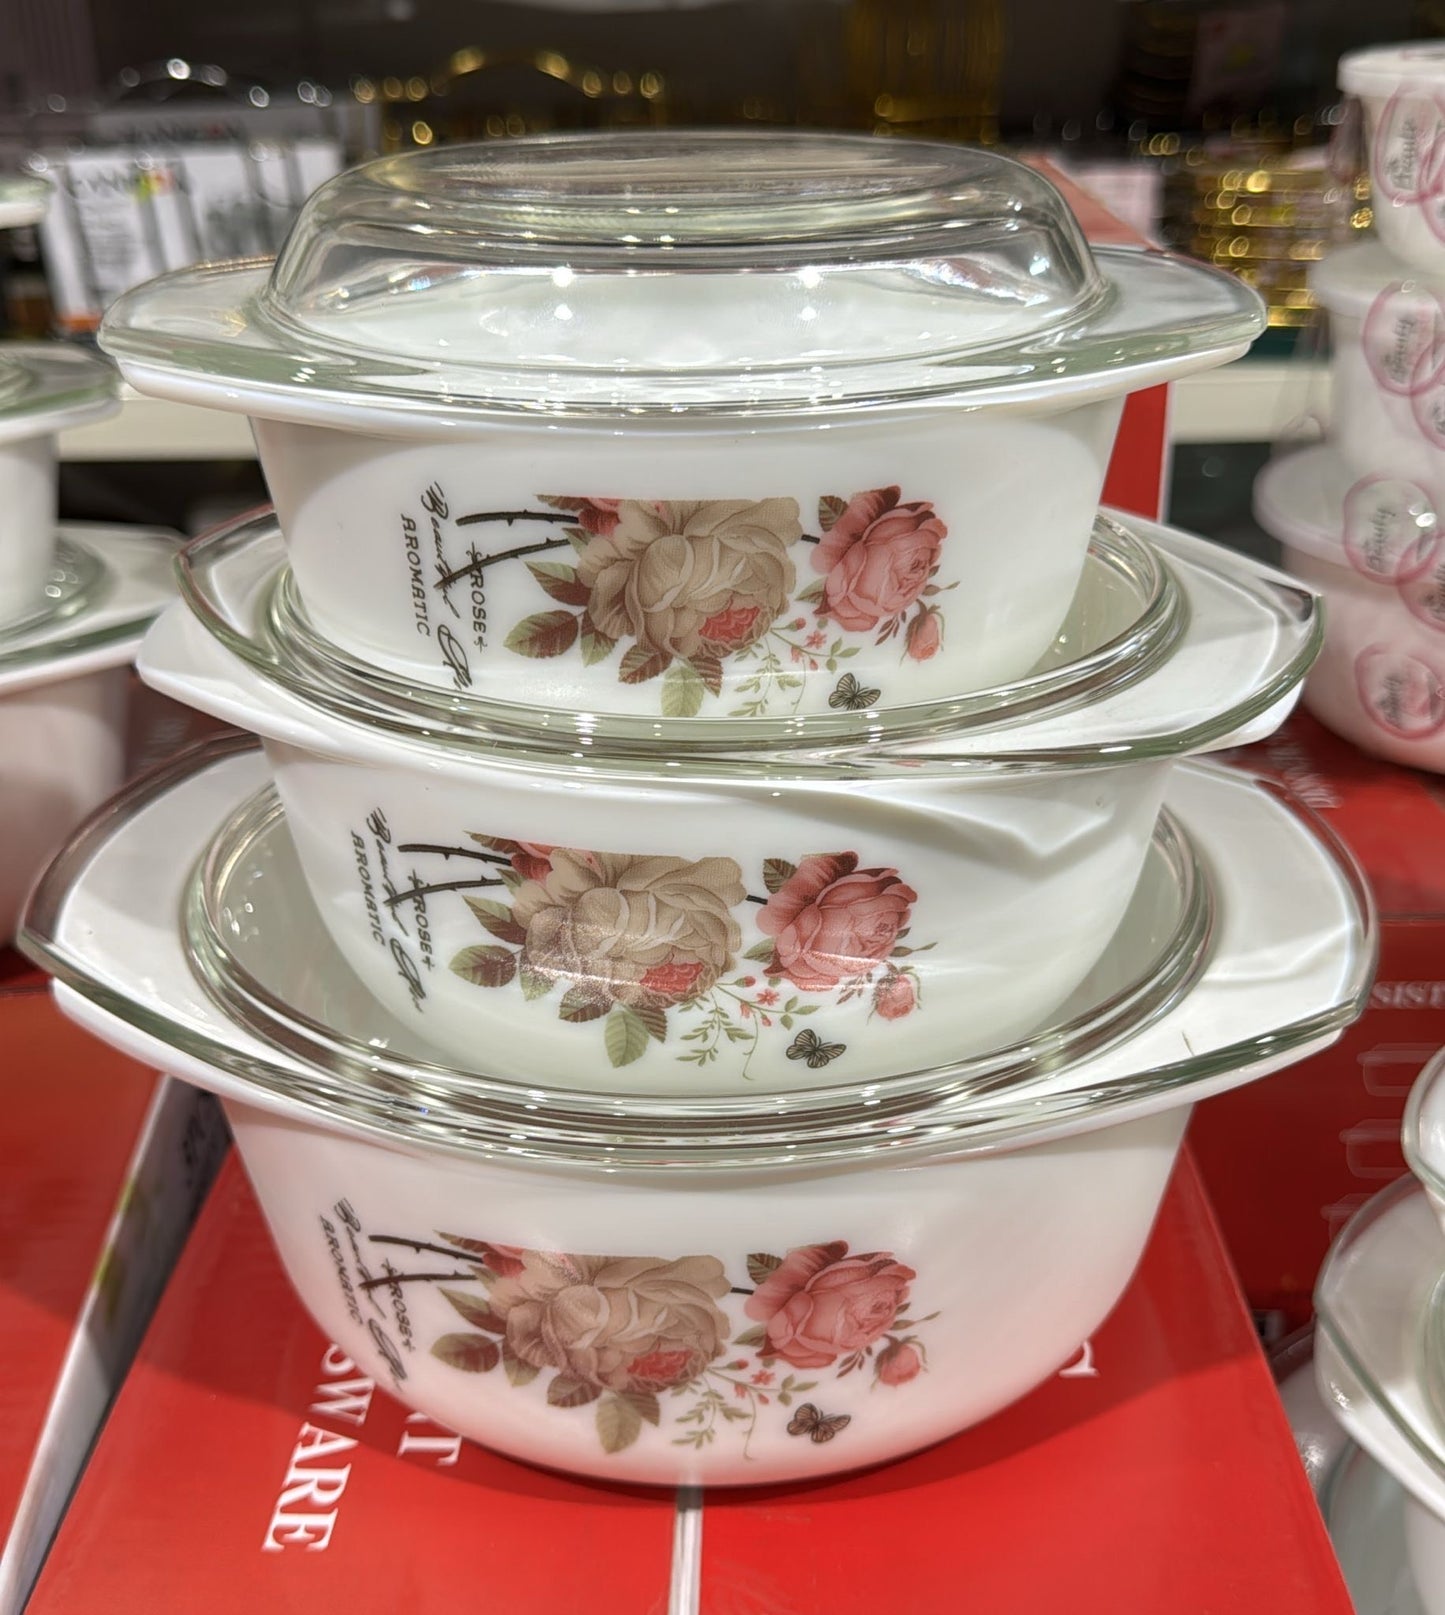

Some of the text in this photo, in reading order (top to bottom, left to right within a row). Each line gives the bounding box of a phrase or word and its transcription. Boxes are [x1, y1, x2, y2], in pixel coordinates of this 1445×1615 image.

[401, 513, 431, 637] AROMATIC
[471, 569, 488, 635] ROSE
[350, 828, 386, 947] AROMATIC
[413, 894, 433, 956] ROSE
